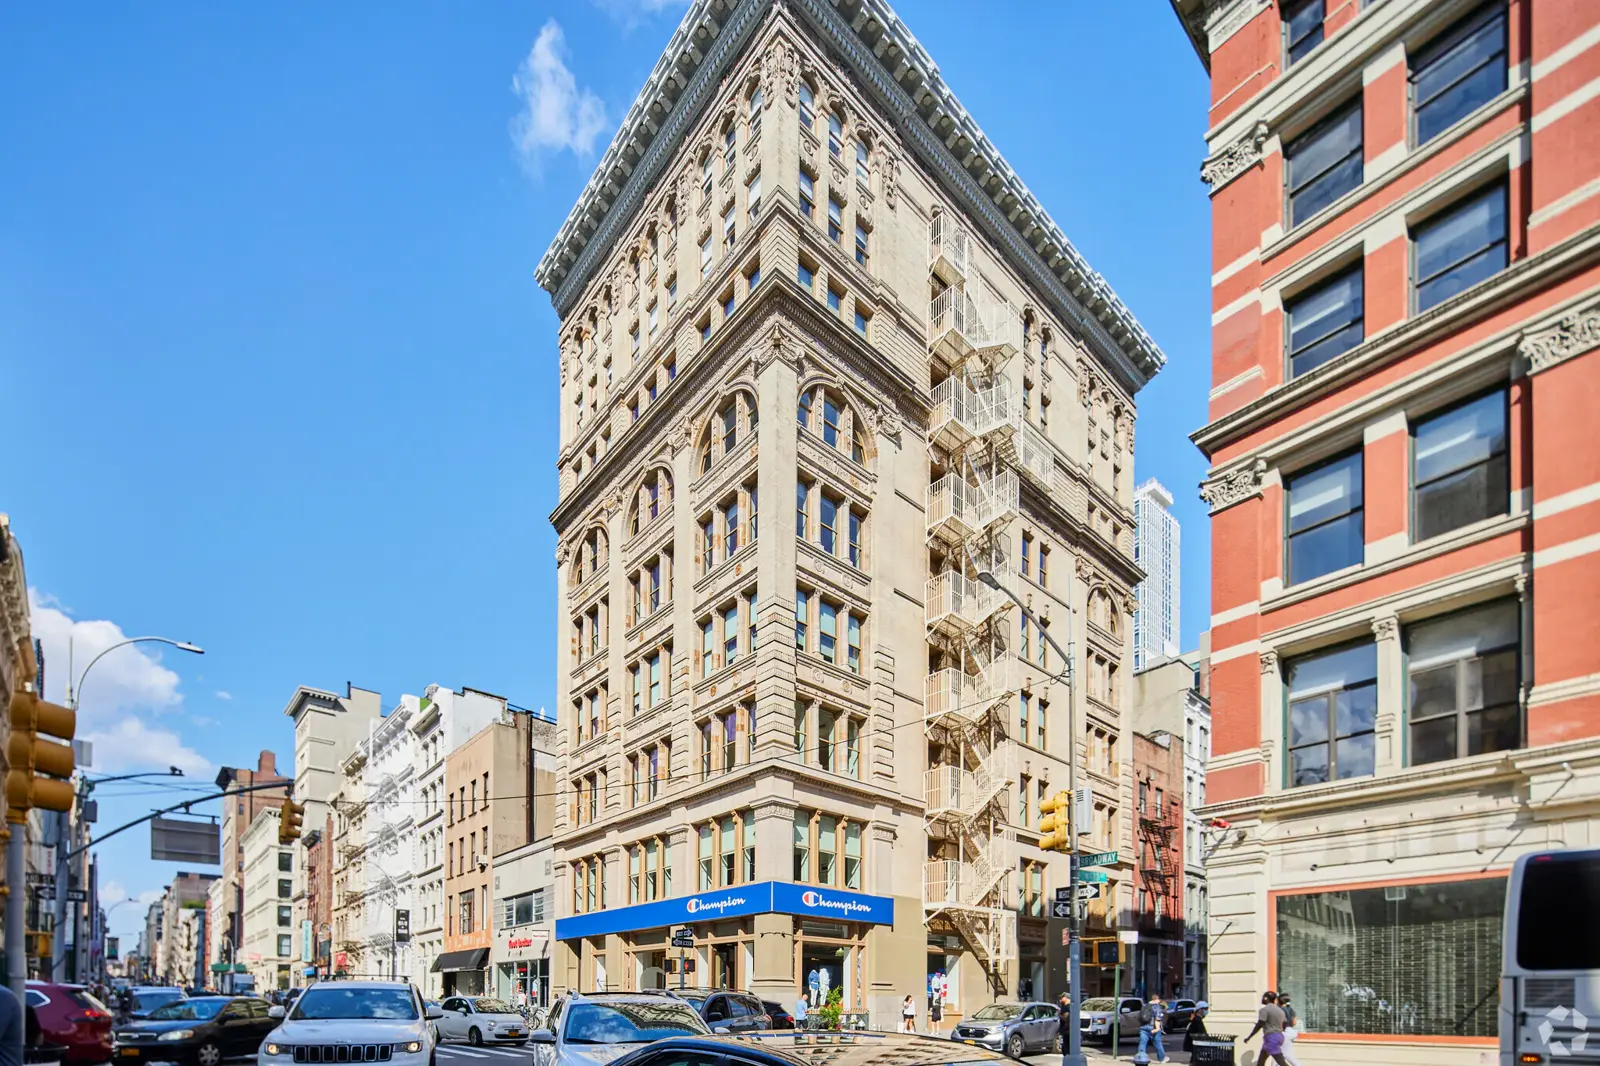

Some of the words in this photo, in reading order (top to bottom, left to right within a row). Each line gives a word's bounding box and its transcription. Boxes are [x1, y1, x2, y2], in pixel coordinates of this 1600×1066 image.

[1080, 852, 1117, 867] BROADWAY
[1080, 888, 1094, 896] WAY
[686, 896, 747, 914] Champion
[801, 890, 872, 916] Champion
